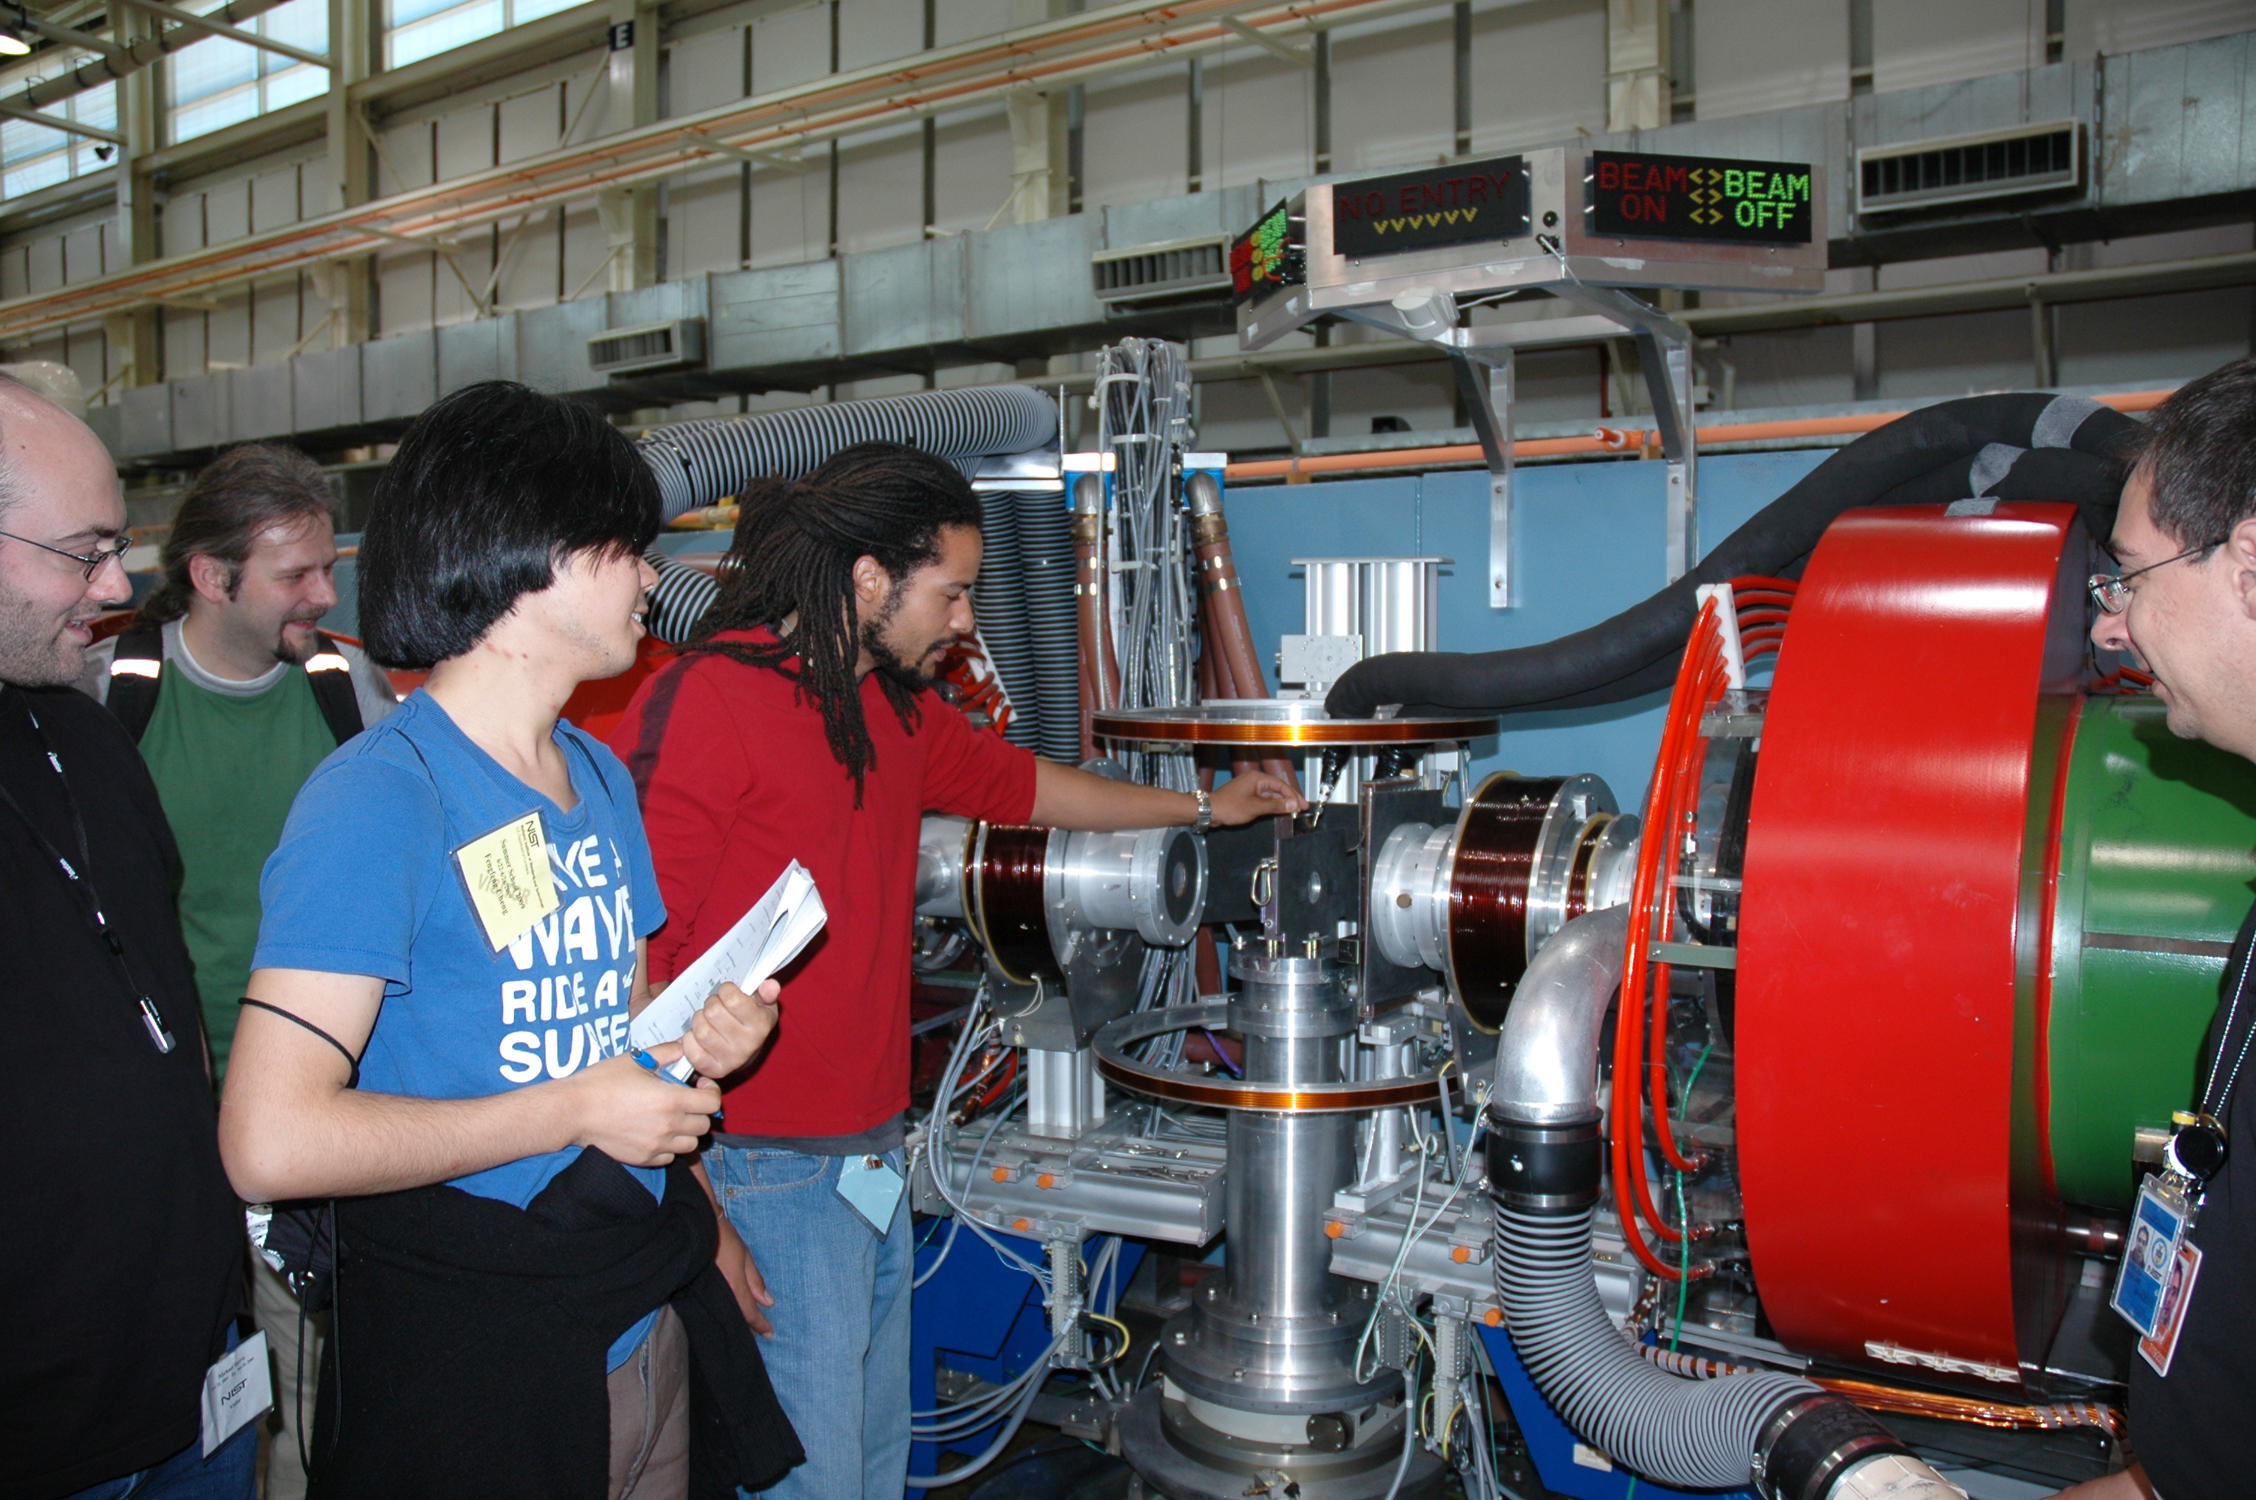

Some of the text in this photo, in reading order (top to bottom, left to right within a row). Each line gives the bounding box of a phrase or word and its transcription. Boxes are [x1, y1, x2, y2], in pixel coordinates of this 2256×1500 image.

[615, 23, 629, 48] E
[1599, 161, 1687, 193] BEAM
[1724, 168, 1810, 202] BEAM
[1340, 169, 1511, 221] NO ENTRY
[1621, 193, 1667, 223] ON
[1736, 200, 1794, 230] OFF
[525, 820, 540, 848] NIST
[500, 972, 588, 1024] RIDE
[595, 969, 618, 1010] A
